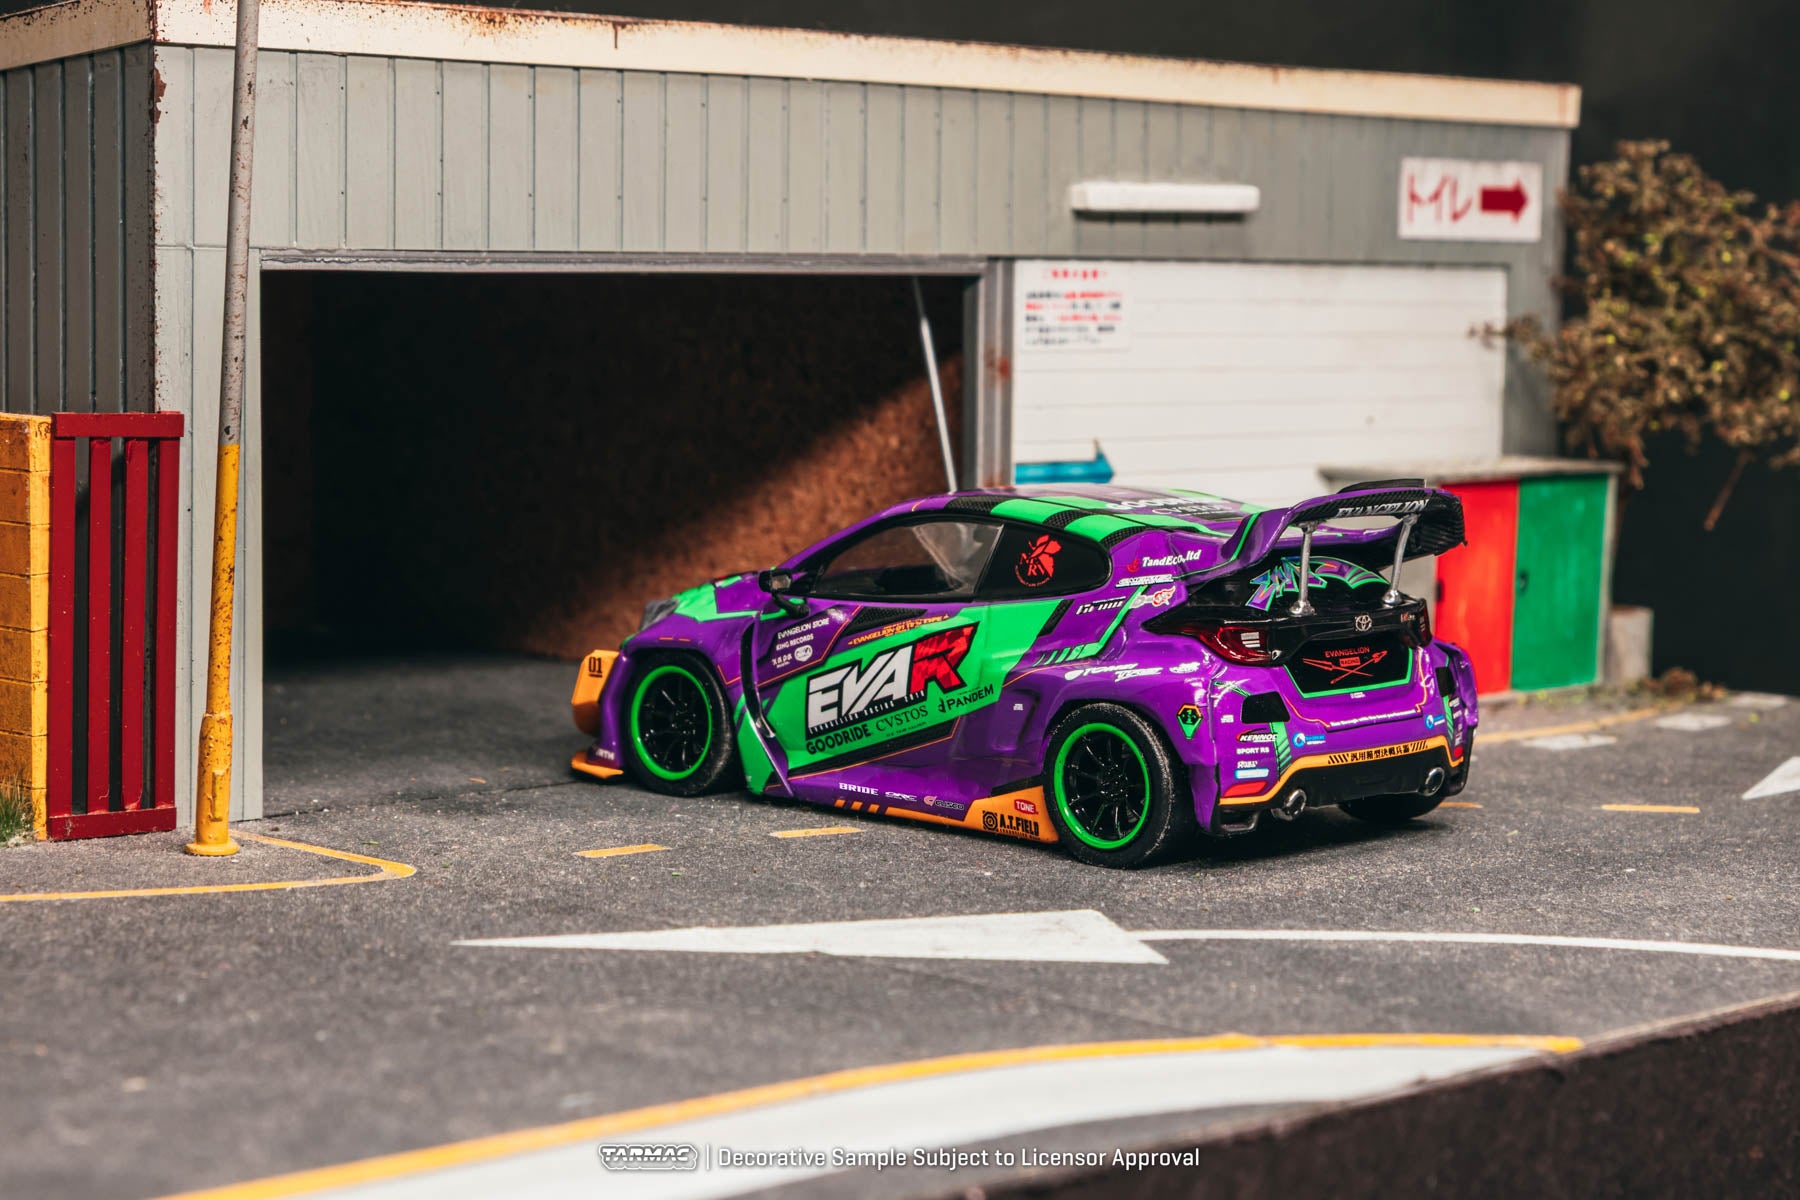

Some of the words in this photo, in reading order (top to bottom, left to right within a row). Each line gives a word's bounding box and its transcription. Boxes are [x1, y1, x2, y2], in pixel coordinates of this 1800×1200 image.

[1407, 174, 1473, 224] トイレ
[777, 622, 812, 640] EVANGELION
[812, 617, 830, 629] STORE
[775, 641, 790, 651] KING
[789, 633, 814, 646] RECORDS
[1324, 645, 1370, 658] EVANGELION
[588, 656, 602, 673] 01
[946, 684, 994, 710] PANDEM
[863, 700, 895, 716] RACING
[875, 705, 929, 731] CVSTOS
[805, 723, 872, 755] GOODRIDE
[838, 782, 879, 796] BRIDE
[1015, 801, 1035, 813] TONE
[1000, 814, 1040, 836] A.T.FIELD
